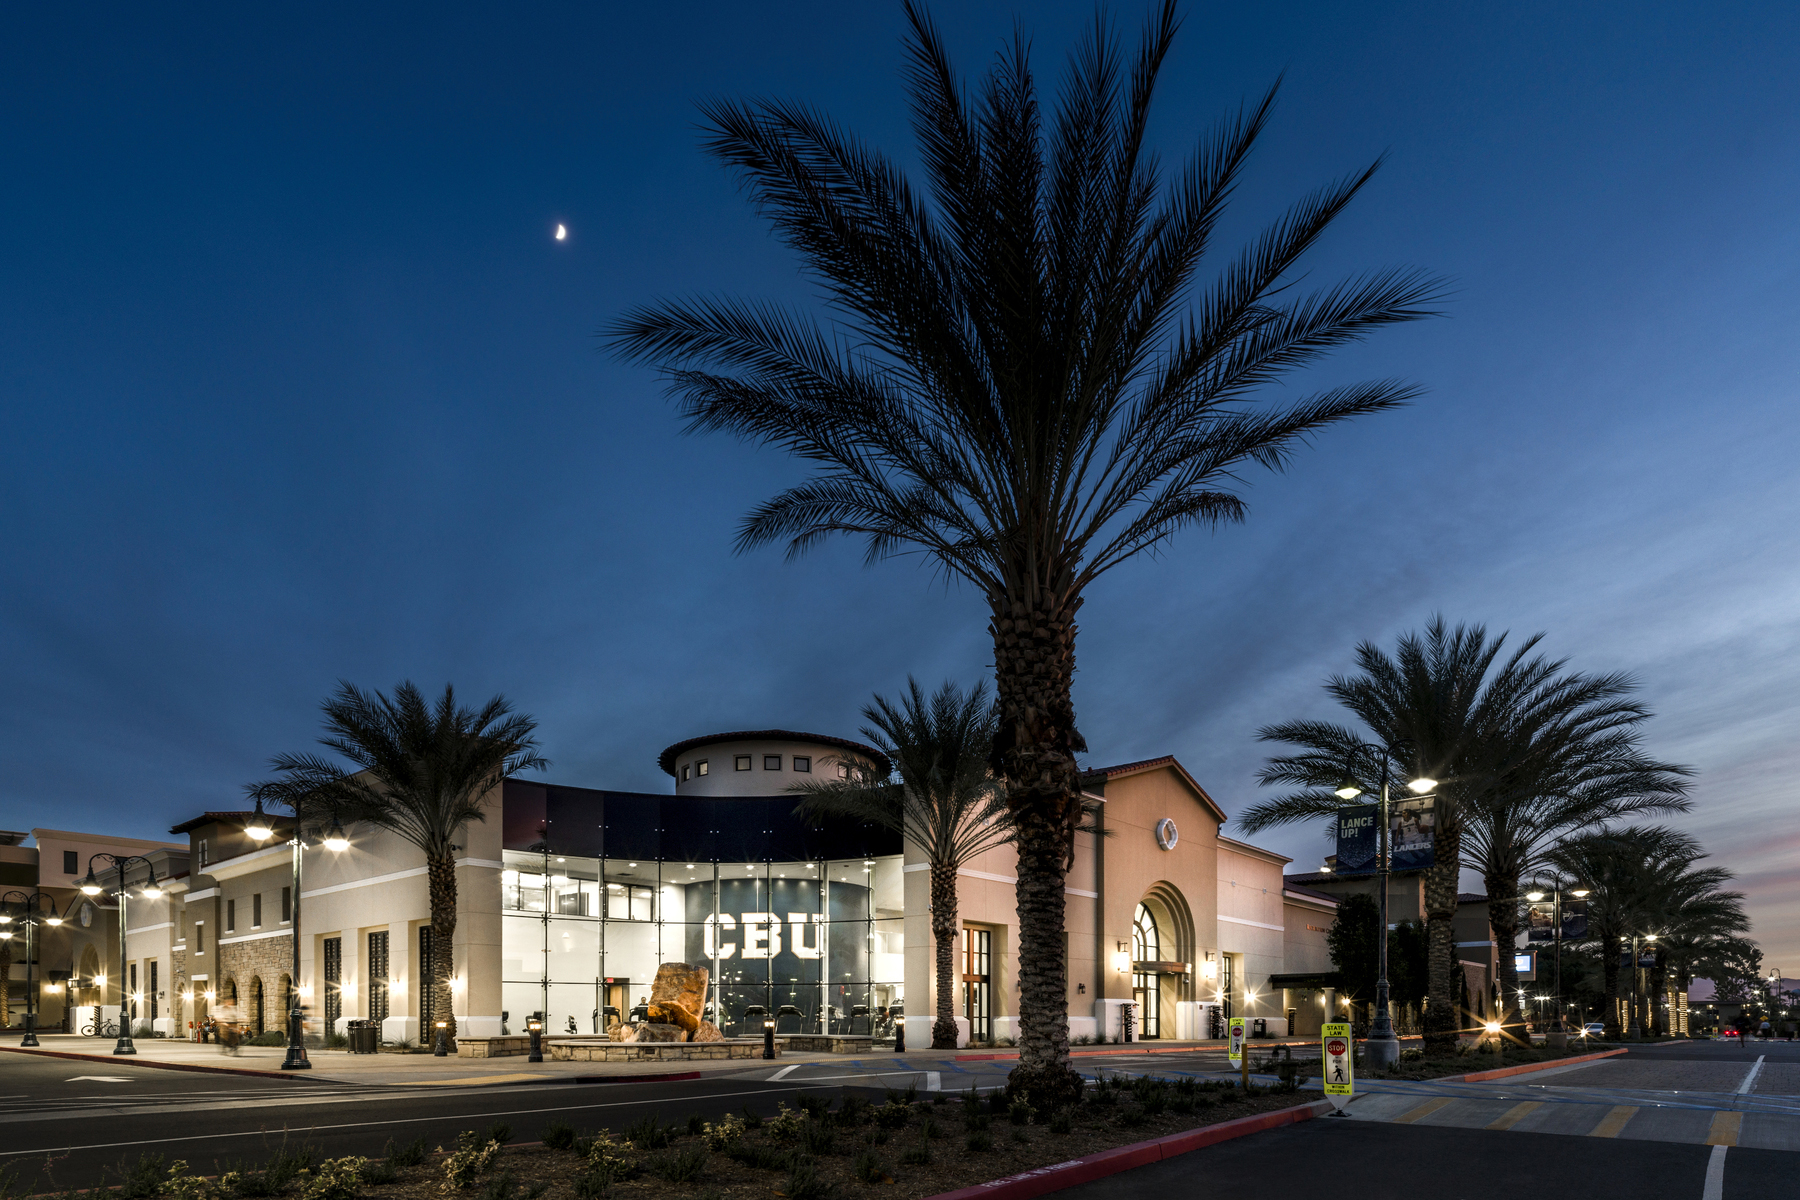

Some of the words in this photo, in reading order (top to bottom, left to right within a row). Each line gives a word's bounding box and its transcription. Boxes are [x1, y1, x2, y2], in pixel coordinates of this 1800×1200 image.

[1341, 816, 1374, 829] LANCE
[1341, 828, 1358, 839] UP!
[1393, 842, 1432, 852] LANCERS
[703, 912, 830, 960] CBU
